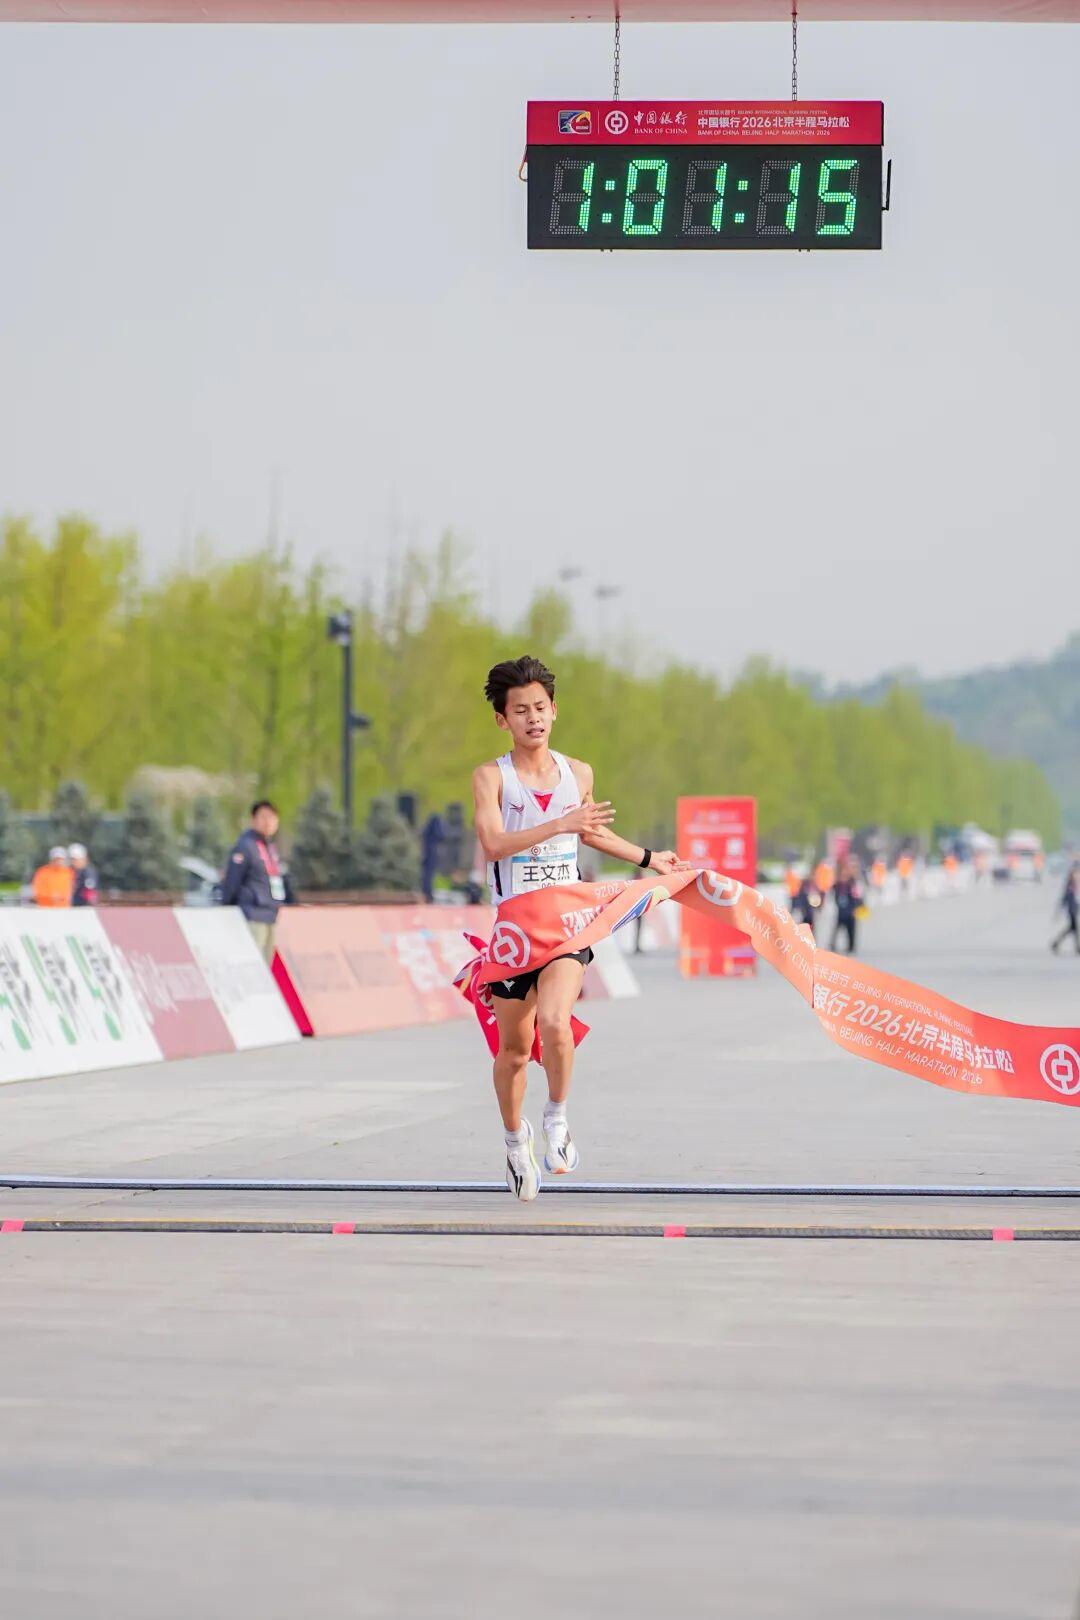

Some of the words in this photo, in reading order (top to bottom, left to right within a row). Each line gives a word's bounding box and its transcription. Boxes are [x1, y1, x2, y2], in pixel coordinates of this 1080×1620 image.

[633, 110, 688, 126] 中国银行
[579, 159, 858, 235] 1:01:15
[522, 863, 570, 882] 王文杰
[744, 910, 772, 941] BANK
[775, 937, 793, 954] OF
[852, 980, 882, 999] BEIJING
[883, 993, 932, 1017] INTERNATIONAL
[839, 1025, 873, 1047] BEIJING
[876, 1040, 903, 1057] HALF
[904, 1051, 958, 1078] MARATHON
[961, 1069, 983, 1085] 2026
